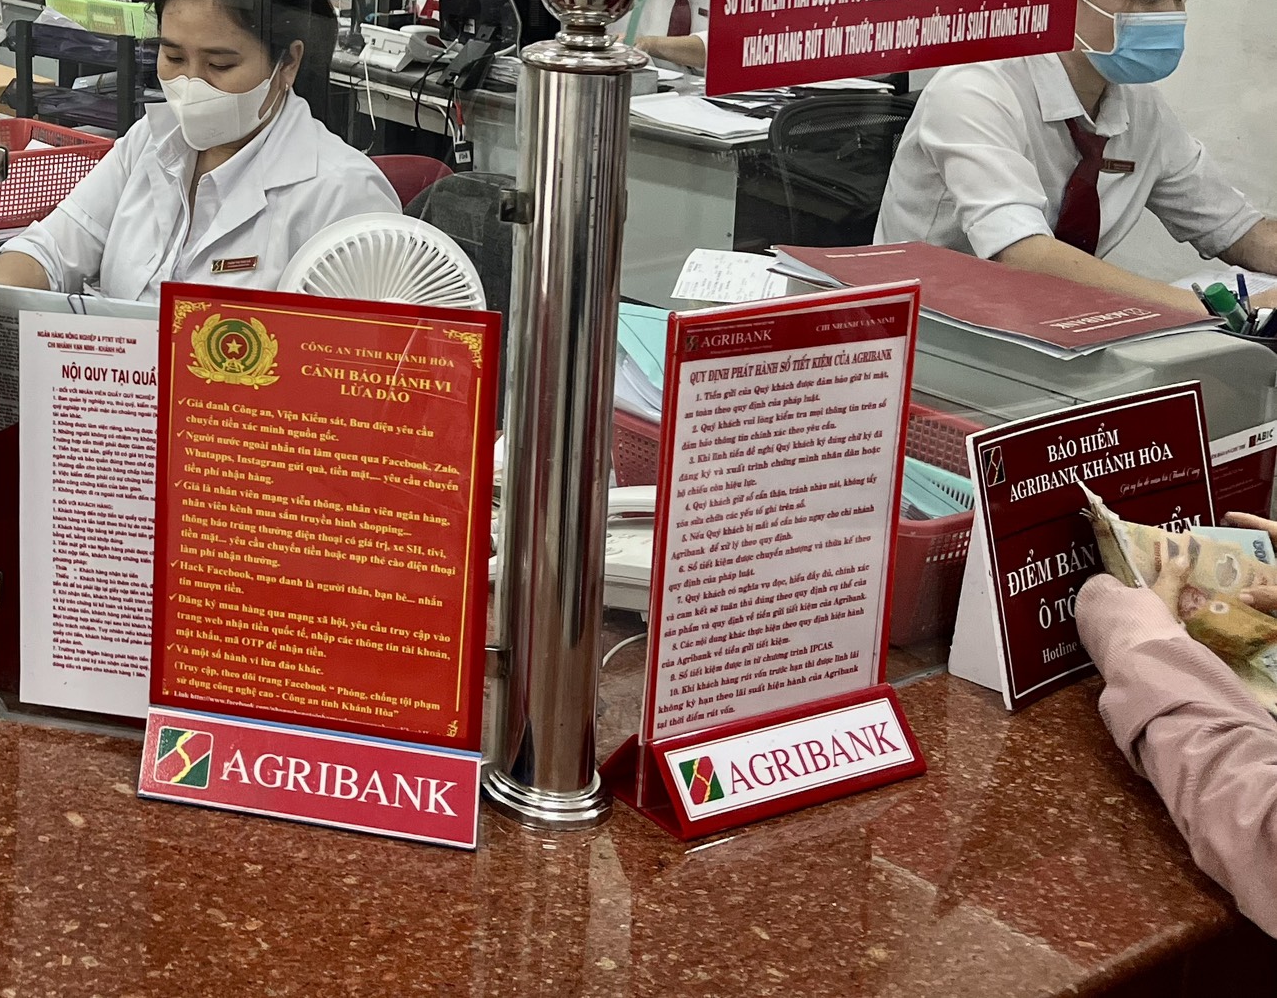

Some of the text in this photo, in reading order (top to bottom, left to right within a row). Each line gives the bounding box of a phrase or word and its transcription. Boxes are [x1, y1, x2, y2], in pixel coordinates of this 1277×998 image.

[742, 0, 1049, 67] KHÁCH HÀNG RÚT VỐN TRƯỚC HẠN ĐƯỢC HƯỞNG LÃI SUẤT KHÔNG KỲ HẠN
[701, 329, 772, 348] AGRIBANK
[300, 341, 332, 353] CÔNG
[355, 348, 382, 359] TỈNH
[385, 350, 426, 364] KHÁNH
[430, 356, 454, 367] HÒA
[689, 348, 892, 386] QUY ĐỊNH PHÁT HÀNH SỔ TIẾT KIỆM CỦA AGRIBANK
[62, 362, 81, 383] NỘI
[85, 368, 108, 382] QUY
[111, 369, 129, 386] TẠI
[301, 363, 451, 392] CẢNH BÁO HÀNH VI
[341, 383, 411, 403] LỪA ĐẢO
[695, 393, 702, 401] 1.
[1047, 422, 1120, 463] BẢO HIỂM
[1257, 428, 1273, 442] ABIC
[1009, 441, 1173, 502] AGRIBANK KHÁNH HÒA
[1007, 549, 1053, 597] ĐIỂM
[1055, 542, 1095, 578] BÁN
[1039, 598, 1051, 629] Ô
[1043, 639, 1077, 664] Hotline
[729, 722, 901, 794] AGRIBANK
[220, 749, 458, 817] AGRIBANK
